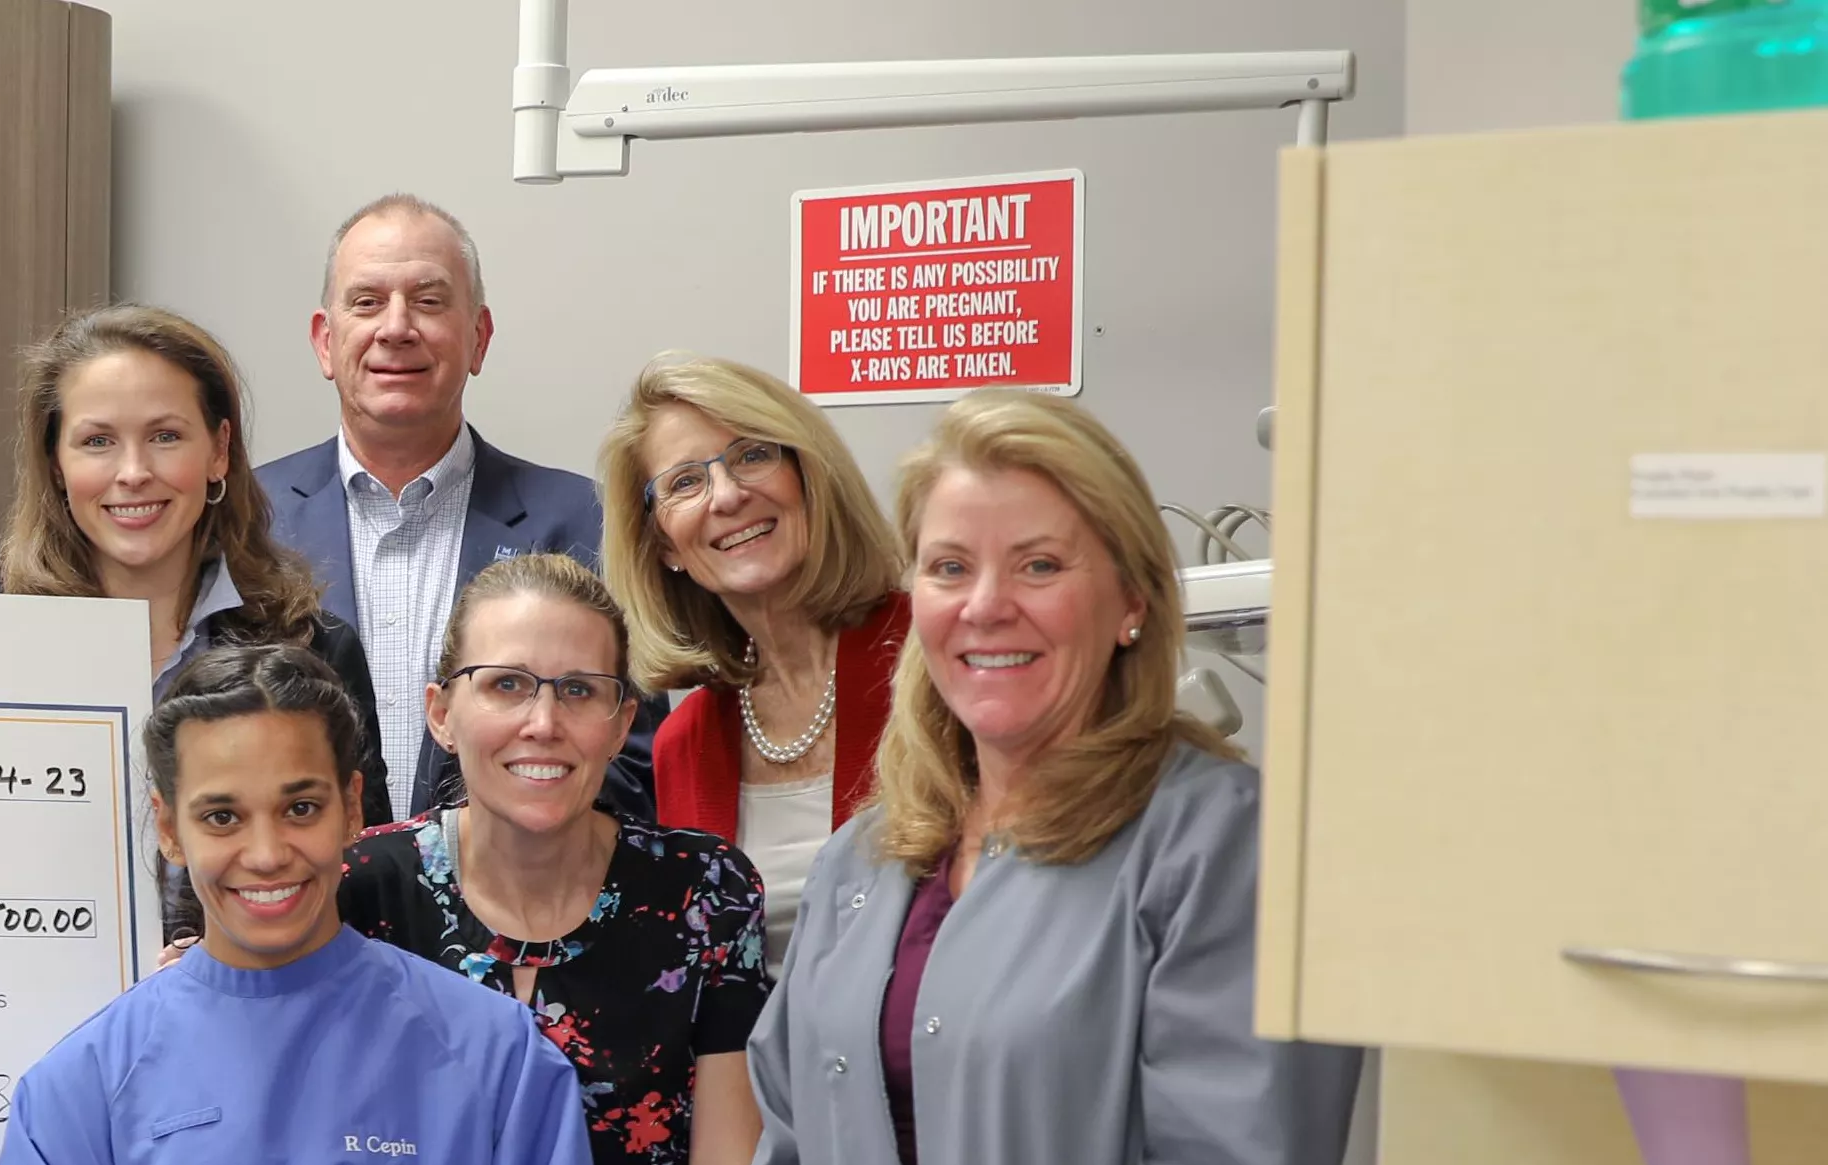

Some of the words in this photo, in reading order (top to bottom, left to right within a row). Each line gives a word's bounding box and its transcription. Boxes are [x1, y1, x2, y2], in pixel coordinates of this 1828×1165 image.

[840, 194, 1031, 251] IMPORTANT
[813, 271, 829, 295] IF
[832, 267, 886, 293] THERE
[891, 265, 908, 291] IS
[912, 263, 947, 289] ANY
[951, 256, 1059, 286] POSSIBILITY
[848, 298, 883, 323] YOU
[887, 295, 920, 320] ARE
[925, 290, 1022, 318] PREGNANT,
[830, 328, 892, 353] PLEASE
[897, 325, 937, 350] TELL
[943, 324, 966, 347] US
[971, 320, 1039, 347] BEFORE
[850, 357, 911, 382] X-RAYS
[915, 355, 950, 379] ARE
[954, 352, 1017, 377] TAKEN.
[343, 1135, 362, 1152] R
[366, 1135, 418, 1157] Cepin
